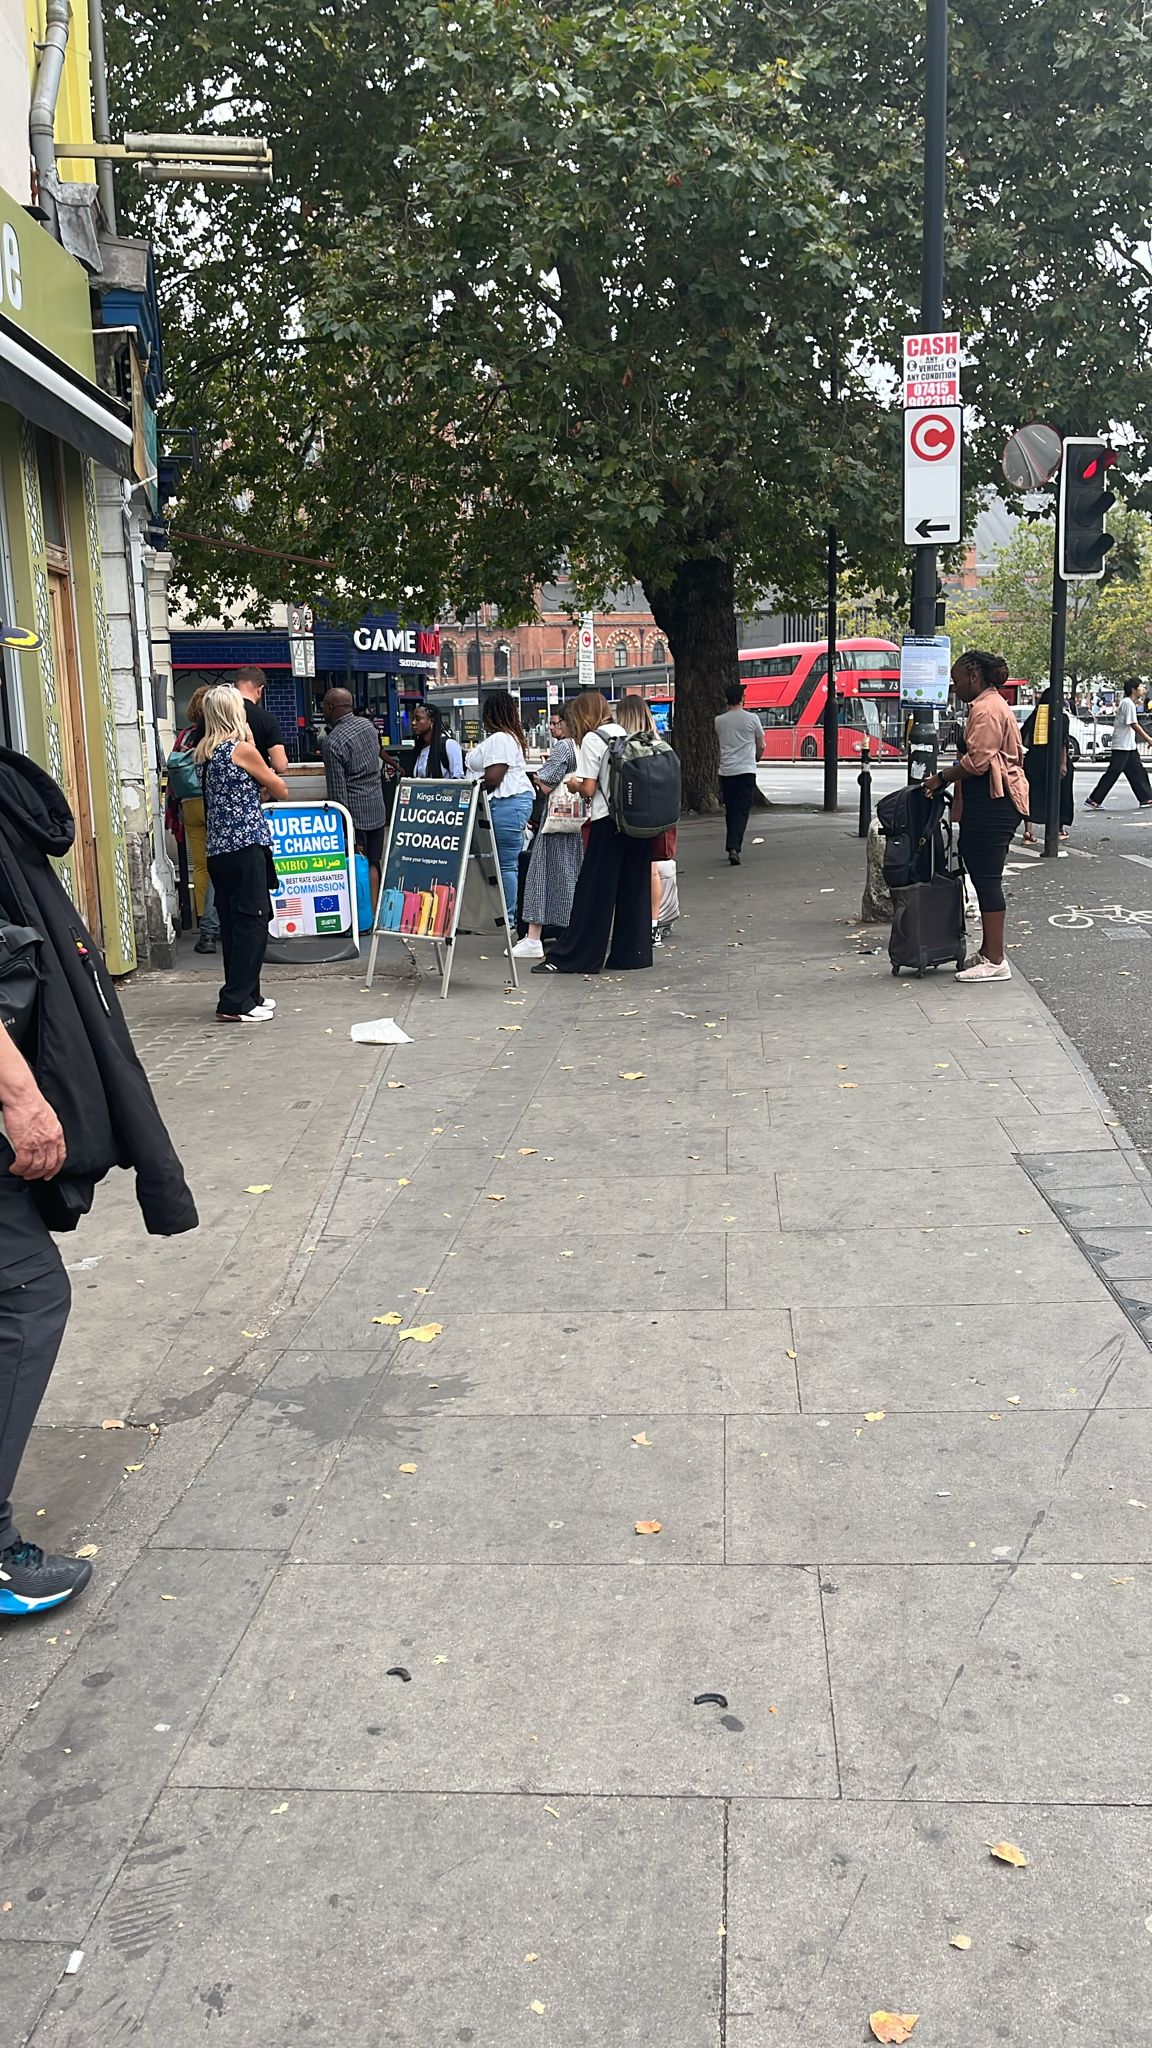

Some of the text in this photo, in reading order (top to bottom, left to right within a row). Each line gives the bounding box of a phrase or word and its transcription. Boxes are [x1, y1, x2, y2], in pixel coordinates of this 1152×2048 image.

[0, 222, 22, 310] e
[907, 336, 957, 356] CASH
[919, 364, 944, 372] VEHICLE
[921, 372, 956, 380] CONDITION
[914, 382, 949, 396] 07415
[915, 419, 949, 457] C
[354, 628, 416, 653] GAME
[889, 682, 898, 690] 73
[416, 792, 453, 802] Kings Cross
[400, 808, 464, 826] LUGGAGE
[266, 815, 337, 837] BUREAU
[269, 835, 339, 855] E CHANGE
[396, 832, 460, 851] STORAGE
[275, 860, 308, 872] AMBIO
[312, 874, 345, 882] GUARANTEED
[286, 882, 345, 895] COMMISSION
